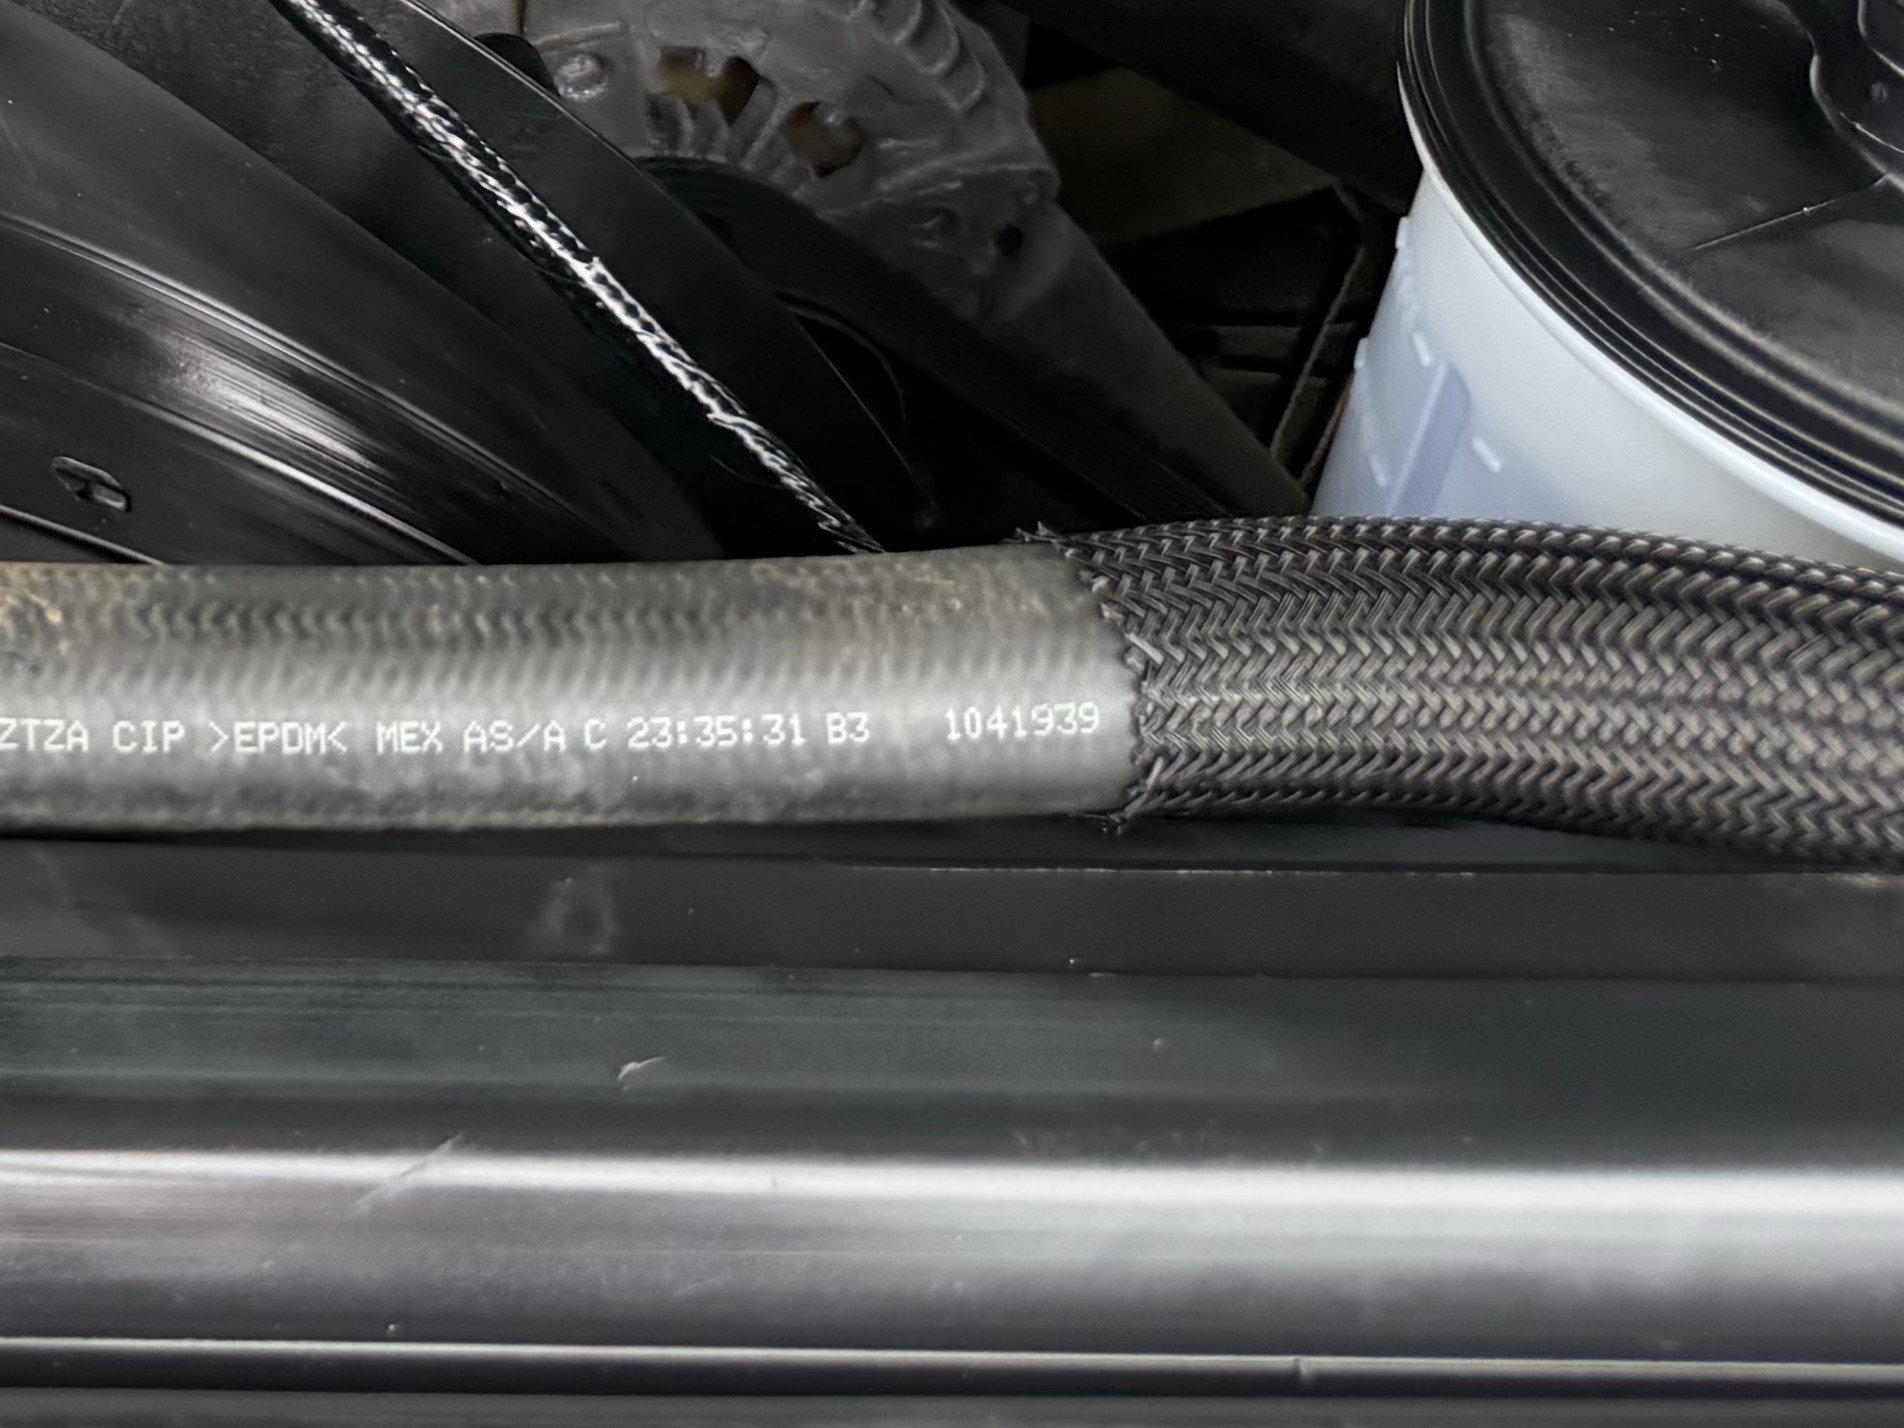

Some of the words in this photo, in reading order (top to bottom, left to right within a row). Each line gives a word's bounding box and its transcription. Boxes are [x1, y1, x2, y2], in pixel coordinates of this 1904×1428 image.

[111, 719, 187, 754] CIP
[208, 719, 349, 755] >EPDM<
[375, 719, 445, 755] MEX
[463, 720, 568, 754] AS/A
[583, 718, 607, 751] C
[625, 712, 807, 749] 23:35:31
[825, 711, 871, 744] B3
[943, 700, 1101, 743] 1041939
